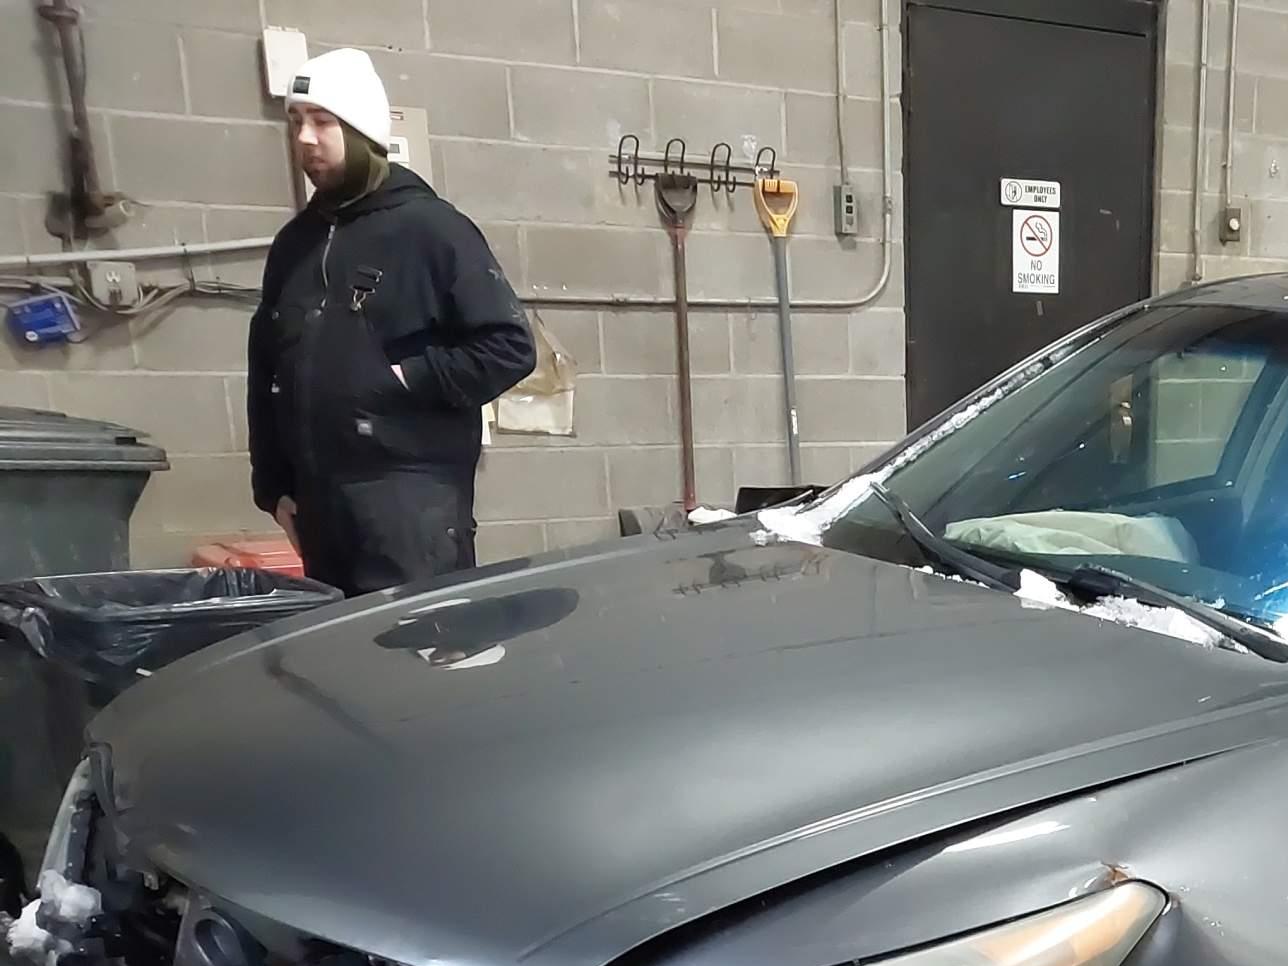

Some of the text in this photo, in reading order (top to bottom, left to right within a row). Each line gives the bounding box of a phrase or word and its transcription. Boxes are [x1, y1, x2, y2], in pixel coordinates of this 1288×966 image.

[1025, 185, 1056, 195] EMPLOYEES
[1034, 195, 1047, 203] ONLY
[1030, 260, 1042, 271] NO
[1018, 272, 1055, 285] SMOKING
